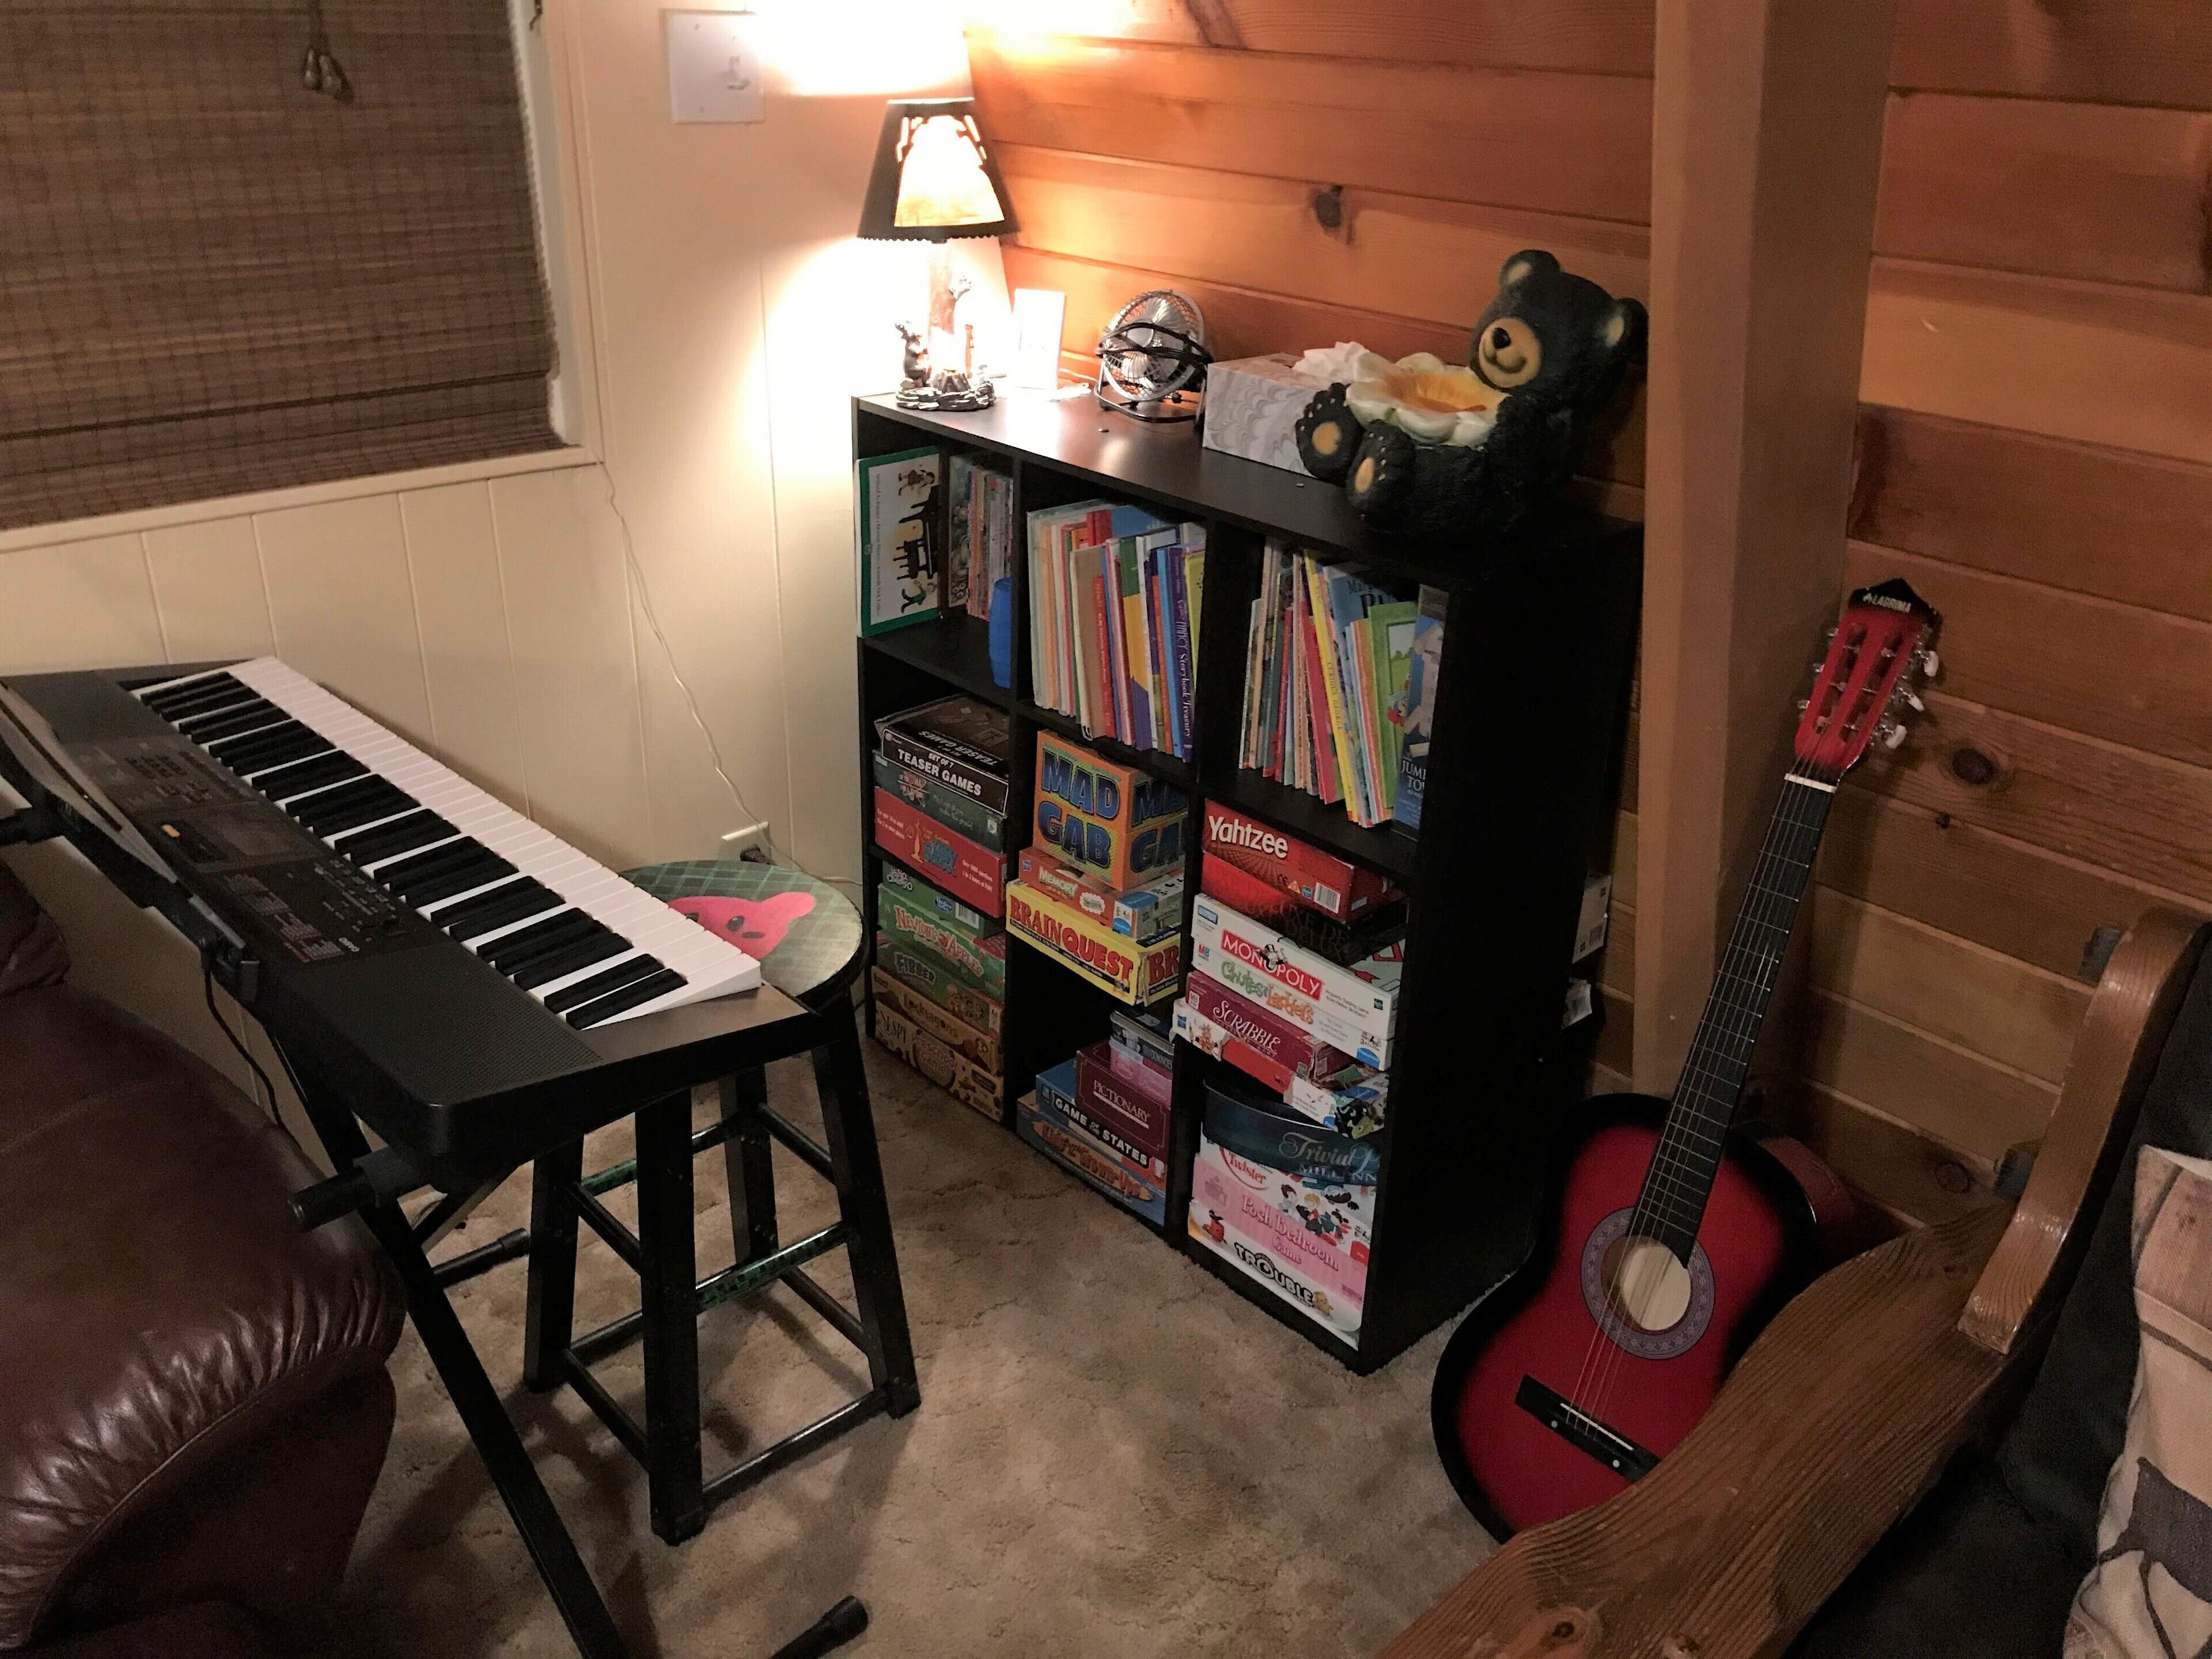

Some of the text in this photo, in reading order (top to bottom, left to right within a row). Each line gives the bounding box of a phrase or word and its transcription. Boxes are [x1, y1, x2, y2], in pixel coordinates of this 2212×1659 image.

[1179, 653, 1191, 698] Storybook
[897, 749, 942, 777] TEASER
[941, 771, 982, 797] GAMES
[1041, 747, 1120, 821] MAD
[1038, 801, 1112, 868] GAB
[1209, 815, 1288, 858] Yahtzee
[1213, 1001, 1282, 1051] SCRABBLE
[1093, 1080, 1150, 1123] PICTIONARY
[1055, 1098, 1087, 1126] GAME
[1102, 1130, 1147, 1166] STATES
[1229, 1152, 1266, 1184] Twister
[1234, 1242, 1315, 1307] TROUBLE
